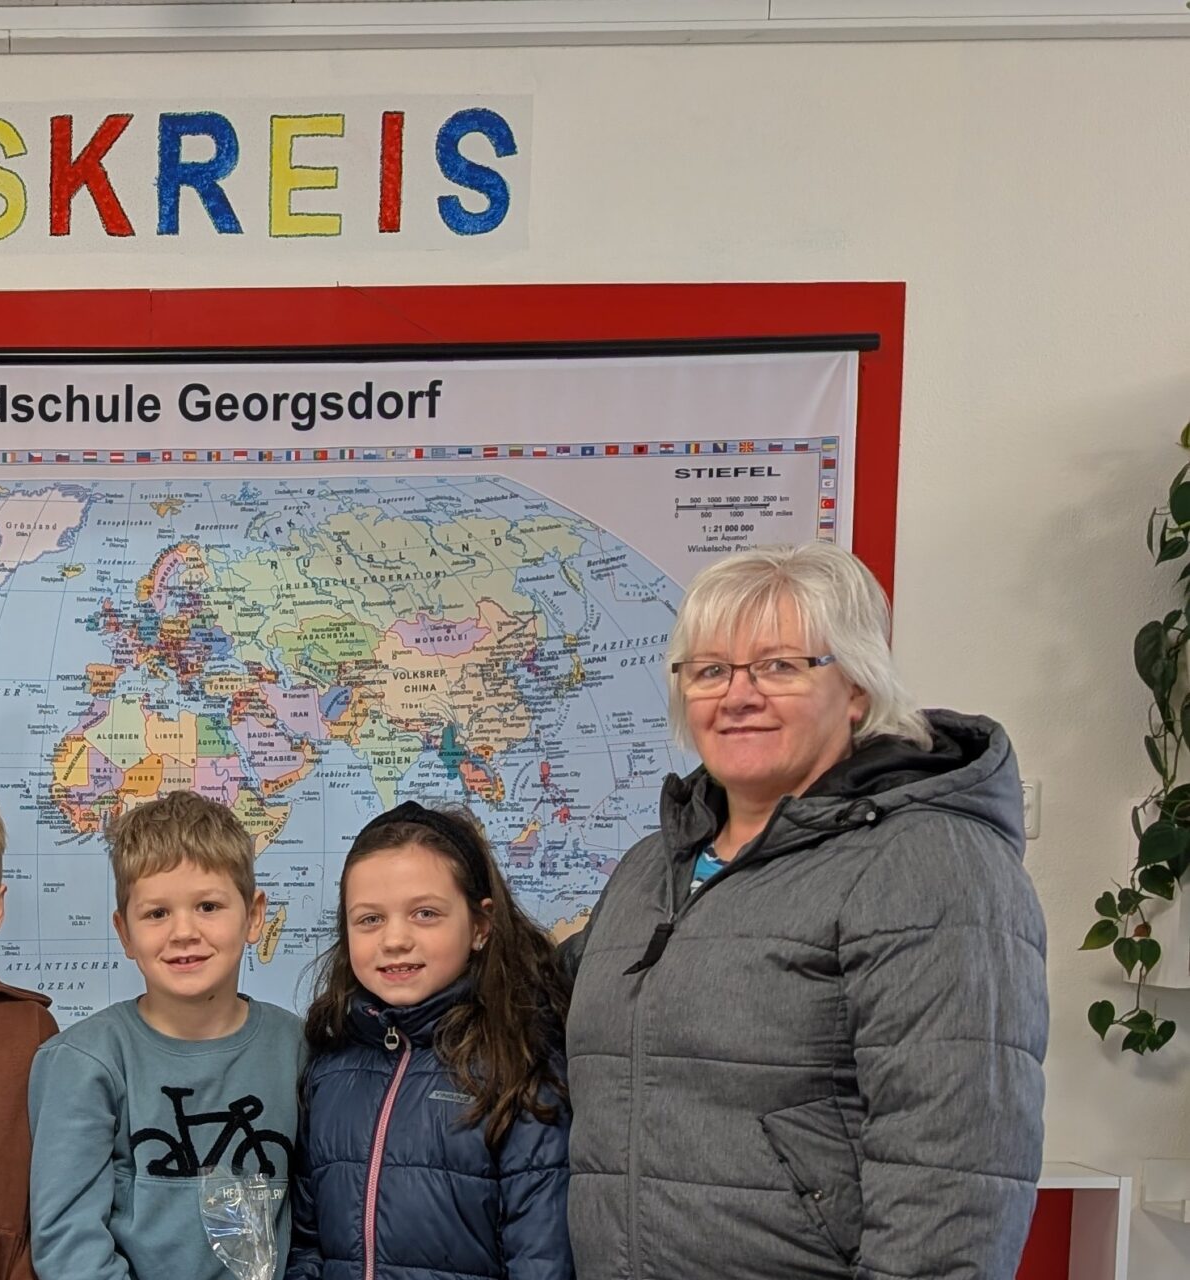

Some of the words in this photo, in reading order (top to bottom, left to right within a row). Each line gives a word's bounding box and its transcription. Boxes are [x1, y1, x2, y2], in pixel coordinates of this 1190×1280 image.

[178, 380, 443, 431] Georgsdorf
[674, 466, 781, 479] STIEFEL
[5, 521, 58, 530] Grönland
[195, 523, 239, 531] Barentssee
[740, 524, 754, 532] 000
[721, 532, 747, 541] Äquator)
[270, 537, 502, 569] RUSSLAND
[688, 544, 732, 553] Winkelsche
[586, 553, 627, 569] Beringmeer
[280, 578, 355, 591] (RUSSISCHE
[296, 632, 355, 641] KASACHSTAN
[415, 634, 468, 643] MONGOLEI
[593, 634, 669, 652] PAZIFISCH
[583, 655, 607, 665] JAPAN
[392, 669, 448, 680] VOLKSREP.
[209, 683, 239, 691] TÜRKEI
[404, 683, 437, 693] CHINA
[62, 743, 87, 781] MAURETANIEN
[372, 756, 411, 765] INDIEN
[418, 761, 433, 769] Golf
[328, 781, 350, 789] Meer
[409, 780, 440, 788] Bengalen
[264, 811, 289, 840] SOMALIA
[262, 917, 280, 957] MADAGASKAR
[6, 961, 119, 971] ATLANTISCHER
[37, 982, 86, 991] OZEAN
